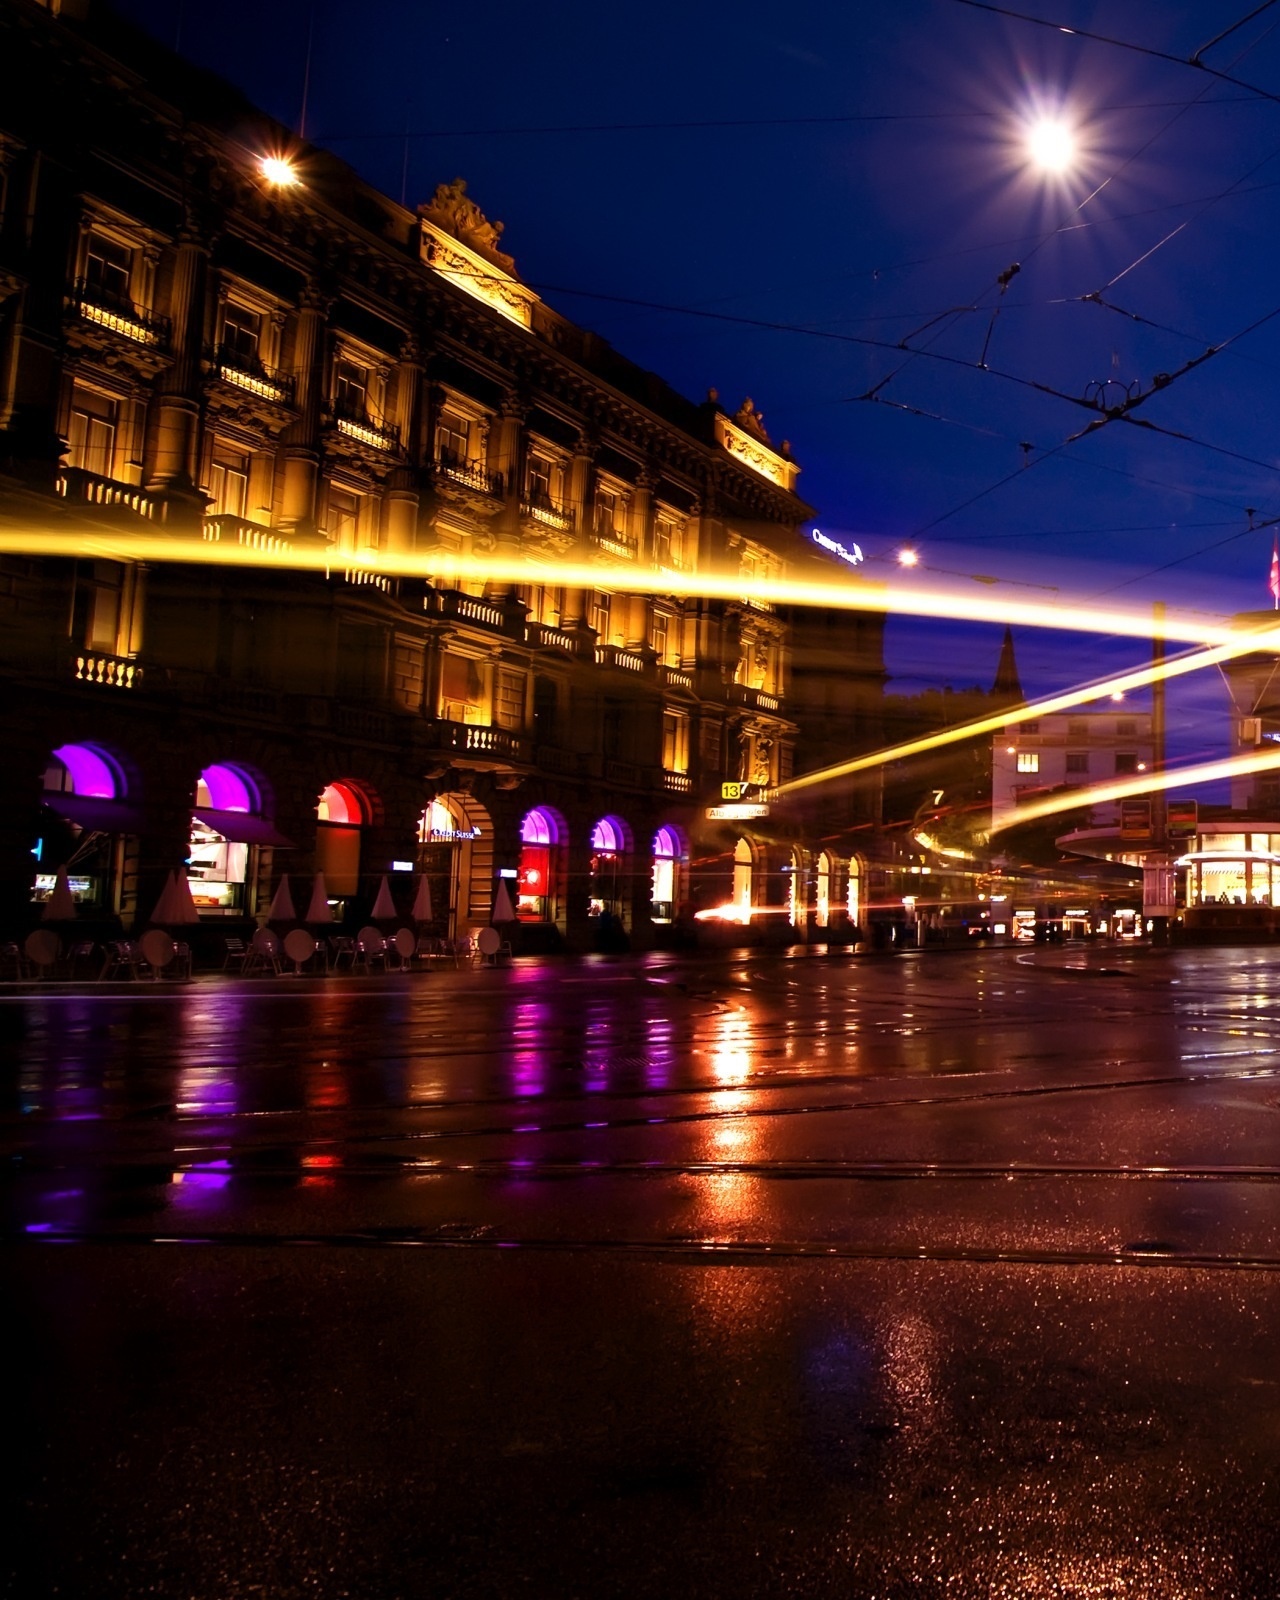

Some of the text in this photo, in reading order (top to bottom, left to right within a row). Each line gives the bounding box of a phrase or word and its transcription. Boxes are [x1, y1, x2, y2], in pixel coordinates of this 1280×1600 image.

[723, 785, 739, 798] 13
[739, 782, 749, 795] 7
[932, 789, 945, 806] 7
